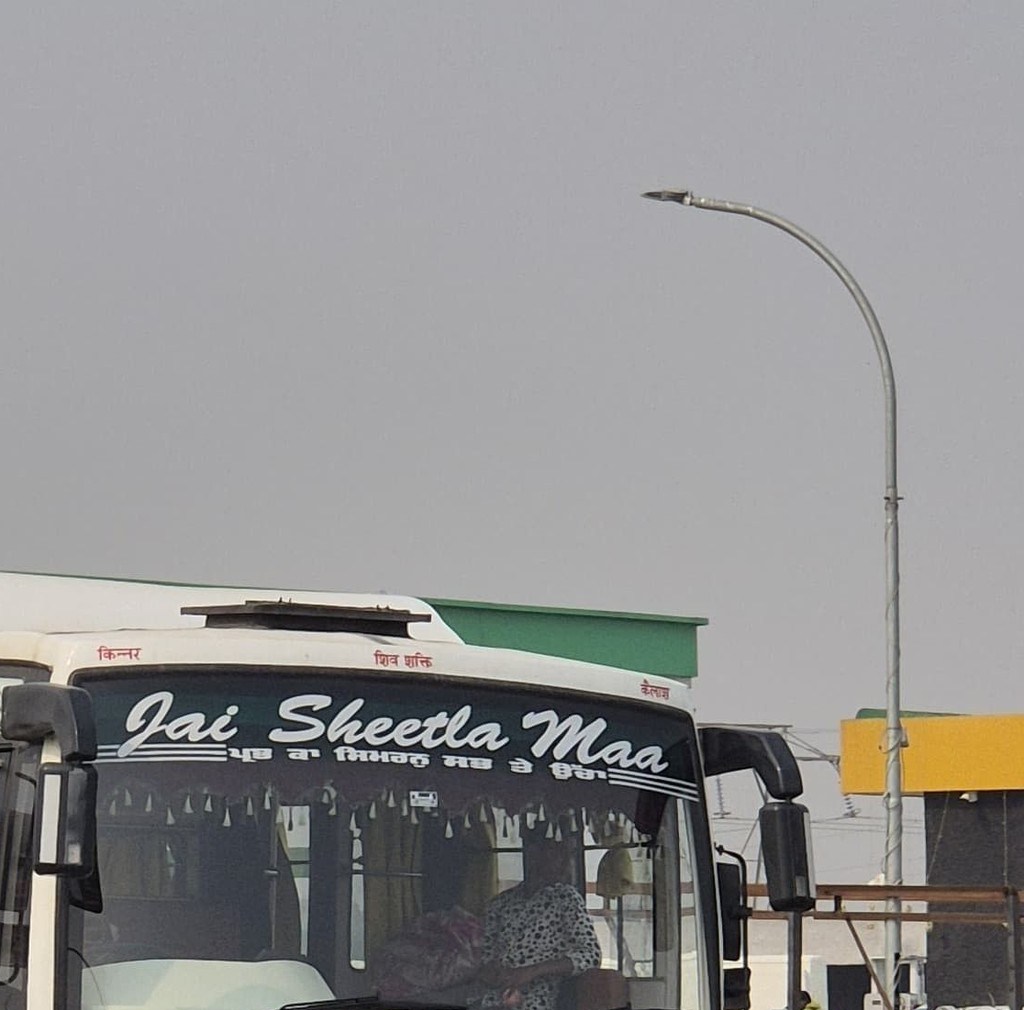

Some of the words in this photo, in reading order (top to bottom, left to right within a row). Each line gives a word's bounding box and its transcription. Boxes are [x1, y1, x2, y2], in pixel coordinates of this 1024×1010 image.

[96, 645, 142, 661] किन्नर
[373, 649, 399, 667] शिव
[403, 651, 433, 669] शक्ति
[117, 691, 239, 758] Jai
[268, 693, 511, 753] Sheetla
[521, 709, 669, 774] Maa
